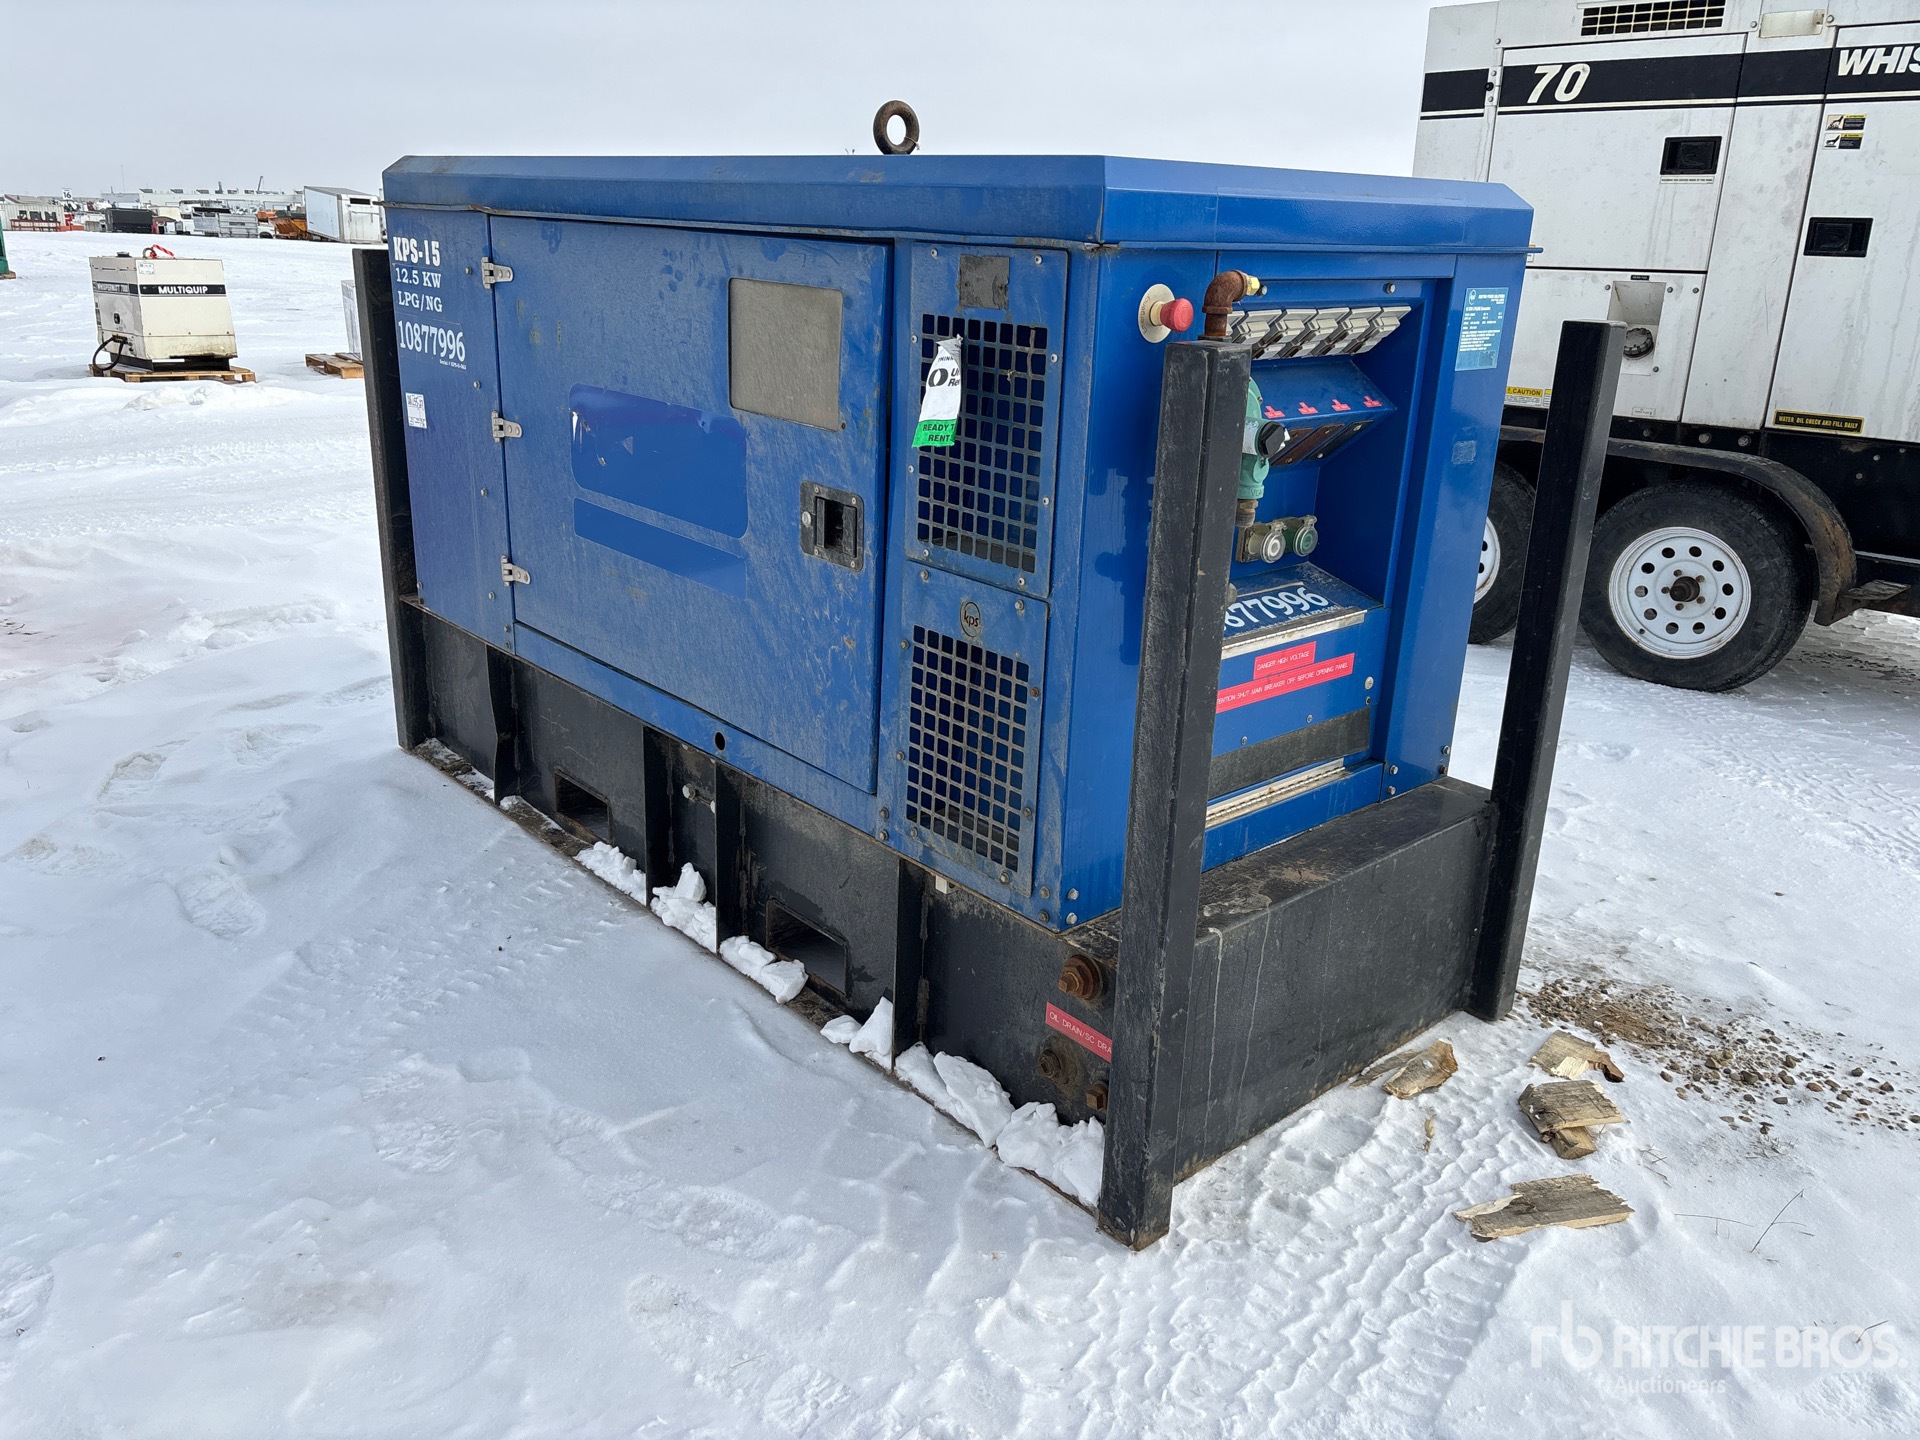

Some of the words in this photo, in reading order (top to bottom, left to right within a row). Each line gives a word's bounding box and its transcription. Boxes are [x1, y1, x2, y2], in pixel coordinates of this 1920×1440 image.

[1527, 63, 1591, 104] 70
[63, 191, 71, 199] 16
[393, 236, 441, 267] KPS-15
[395, 267, 419, 285] 12.5
[422, 271, 441, 288] KW
[158, 286, 208, 294] MULTIQUIP
[398, 290, 443, 313] LPG/NG
[398, 320, 466, 362] 10877996
[1512, 388, 1541, 396] CAUTION
[923, 423, 949, 432] READY
[950, 423, 955, 431] T
[1822, 419, 1832, 427] AND
[1832, 420, 1843, 428] FILL
[928, 434, 951, 442] RENT
[964, 610, 979, 627] kps
[1257, 660, 1276, 670] DANGER
[1278, 657, 1289, 665] HIGH
[1289, 650, 1310, 661] VOLTAGE
[1251, 686, 1263, 695] MAIN
[1264, 680, 1286, 691] BREAKER
[1286, 677, 1296, 685] OFF
[1297, 672, 1315, 682] BEFORE
[1315, 666, 1334, 677] OPENING
[1335, 662, 1349, 671] PANEL
[1049, 1011, 1059, 1023] OIL
